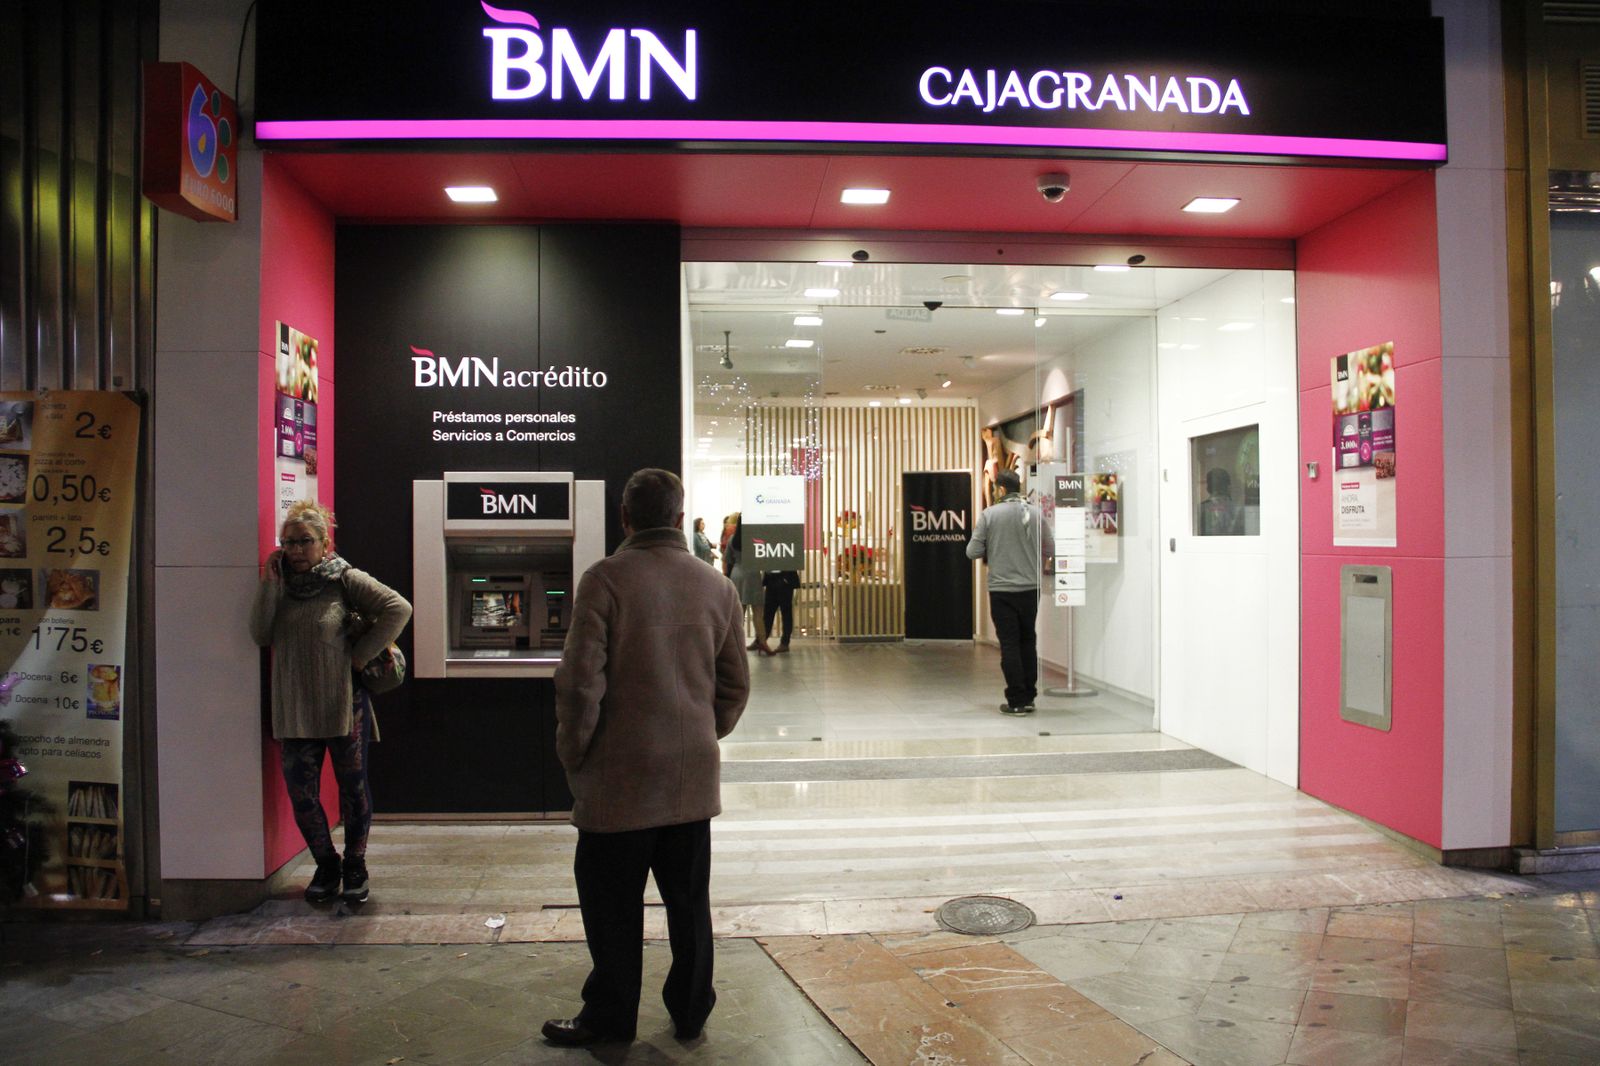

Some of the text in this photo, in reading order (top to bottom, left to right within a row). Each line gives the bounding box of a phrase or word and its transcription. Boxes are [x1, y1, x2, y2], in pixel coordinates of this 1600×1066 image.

[483, 27, 697, 101] BMN
[919, 66, 1250, 116] CAJAGRANADA
[411, 356, 608, 388] BMN acrédito
[76, 411, 112, 439] 2€
[432, 411, 576, 425] Préstamos personales
[432, 429, 576, 442] Servicios a Comercios
[33, 474, 111, 506] 0,50€
[1058, 480, 1082, 490] BMN
[481, 494, 537, 514] BMN
[911, 509, 966, 531] BMN
[47, 526, 110, 557] 2,5€
[912, 534, 966, 542] CAJAGRANADA
[753, 542, 795, 558] BMN
[20, 671, 52, 682] Docena
[60, 671, 79, 684] 6€
[15, 695, 80, 710] Docena 10€
[68, 735, 111, 747] almendra
